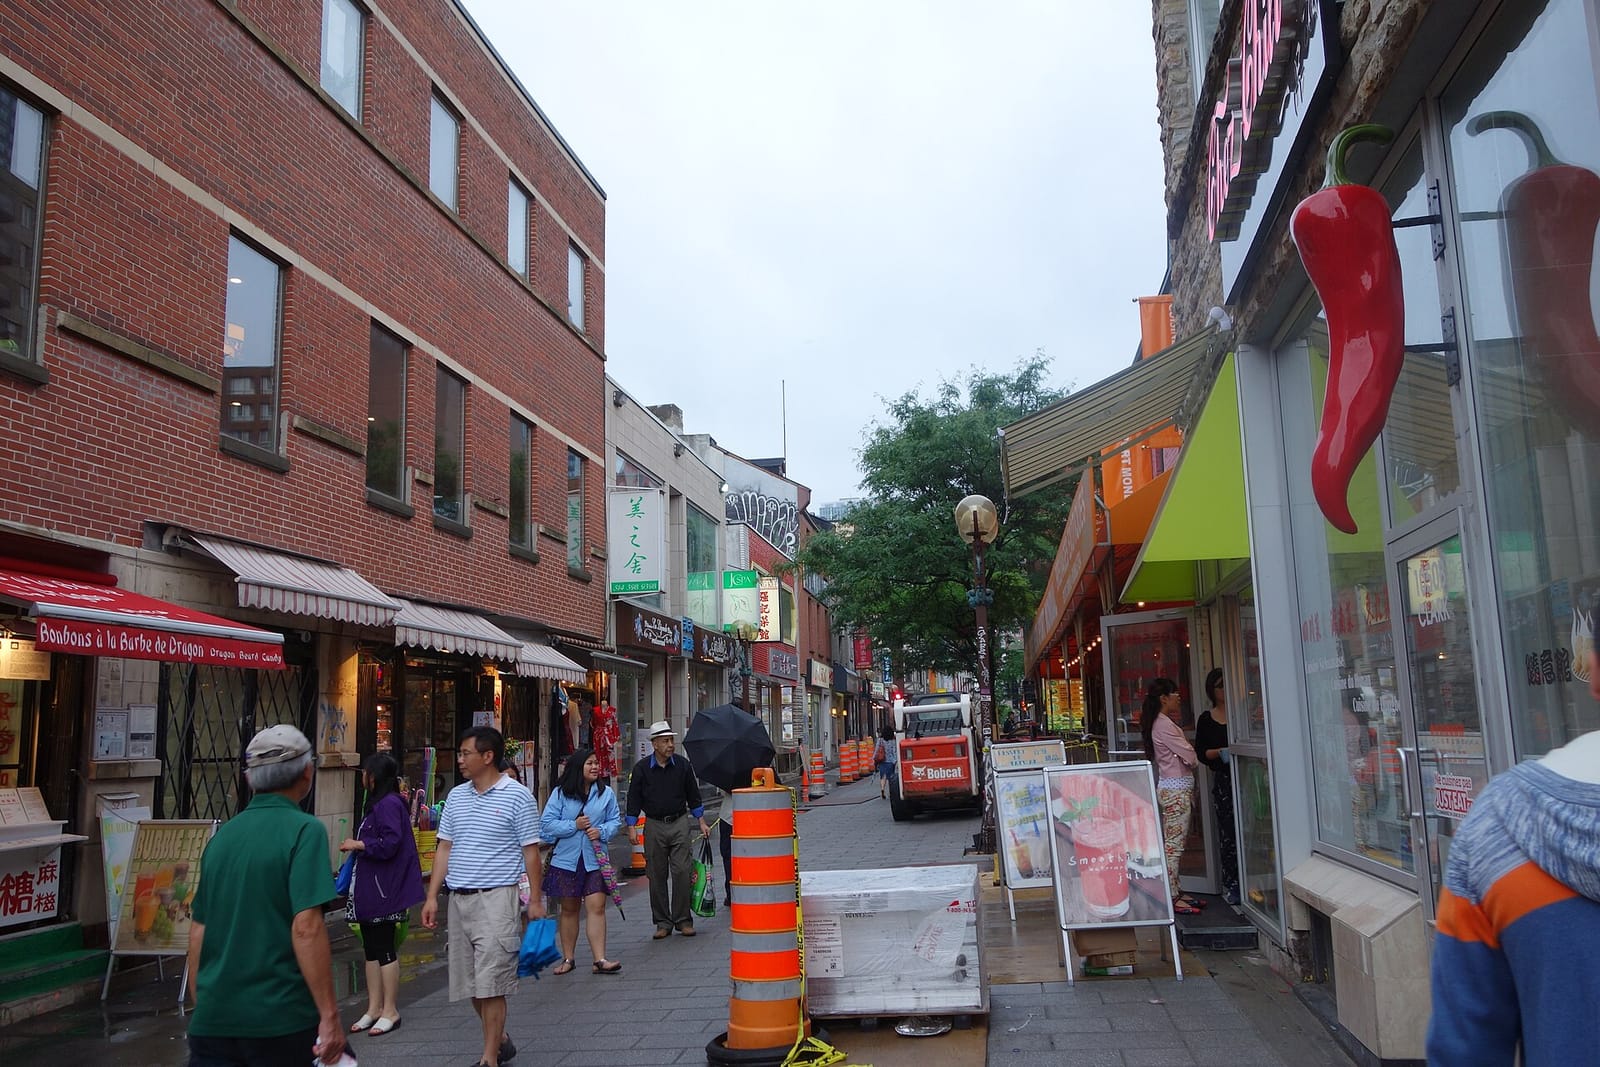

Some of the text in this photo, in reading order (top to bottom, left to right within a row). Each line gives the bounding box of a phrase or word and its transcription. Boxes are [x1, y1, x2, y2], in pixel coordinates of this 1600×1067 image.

[40, 622, 282, 665] Bonbons à la Barbe de Dragon Dragon Beard Candy
[927, 766, 963, 779] Bobcat
